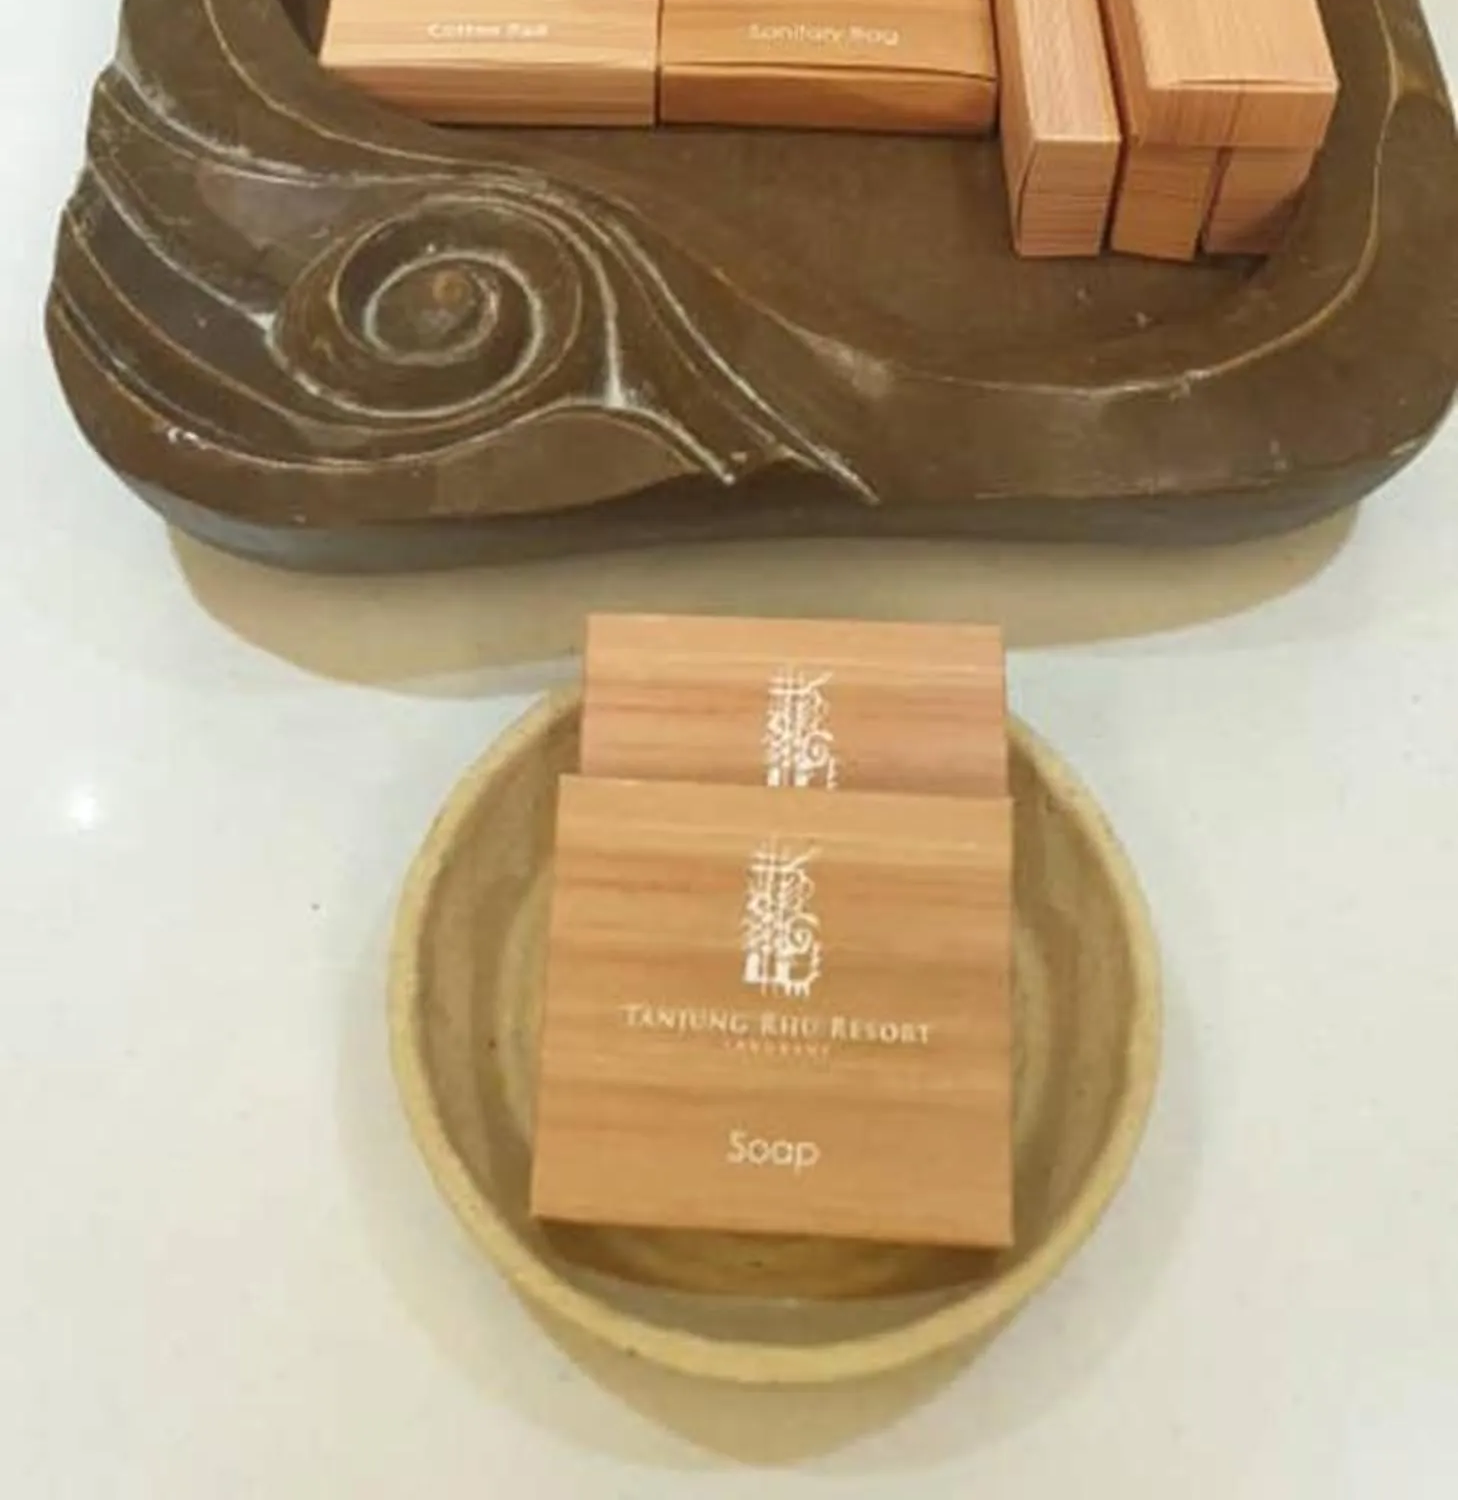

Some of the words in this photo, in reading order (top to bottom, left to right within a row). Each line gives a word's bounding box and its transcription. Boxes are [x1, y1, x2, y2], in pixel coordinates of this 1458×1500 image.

[427, 23, 501, 38] Cotton
[749, 22, 845, 44] Sanitary
[849, 25, 899, 46] Bag
[621, 1003, 749, 1034] TANJUNG
[759, 1011, 822, 1038] RHU
[831, 1016, 930, 1045] RESORT
[727, 1128, 821, 1177] Soap
